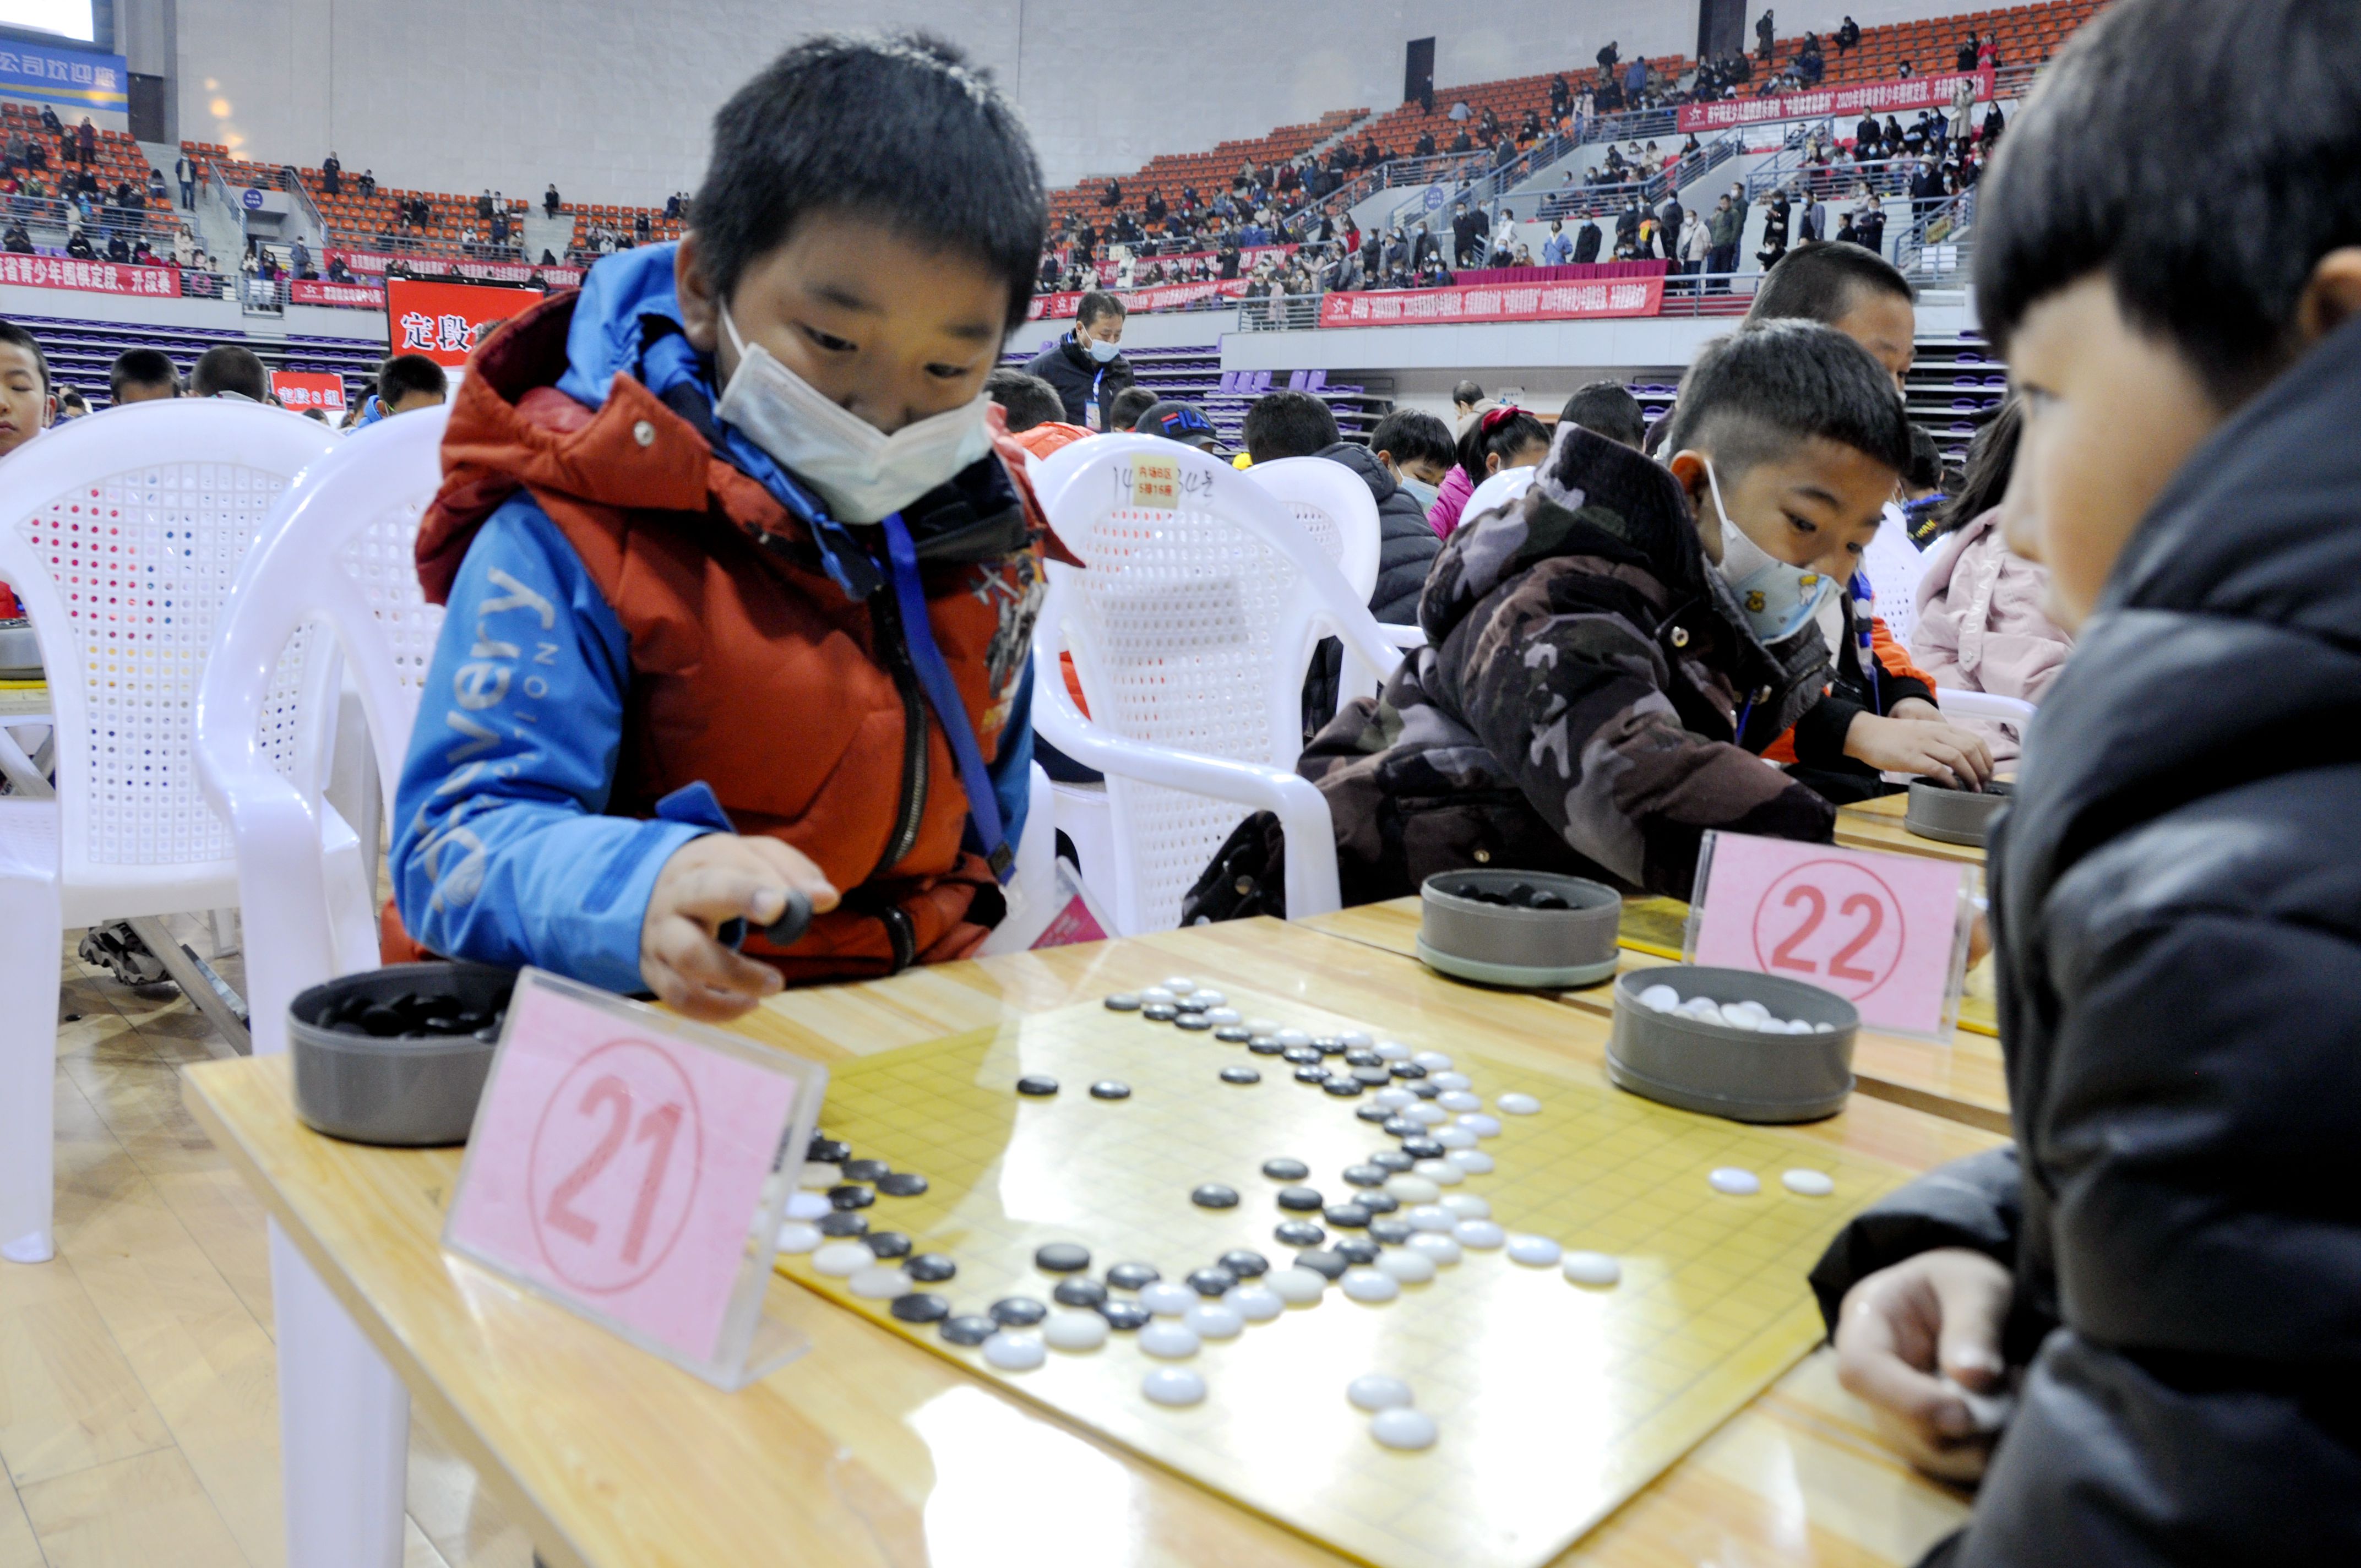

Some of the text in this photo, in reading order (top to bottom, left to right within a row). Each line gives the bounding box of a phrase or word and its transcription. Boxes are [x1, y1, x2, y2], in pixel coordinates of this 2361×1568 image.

[0, 52, 116, 89] 公司欢迎您
[1160, 409, 1210, 435] FILA
[1771, 884, 1884, 983] 22
[543, 1074, 684, 1267] 21
